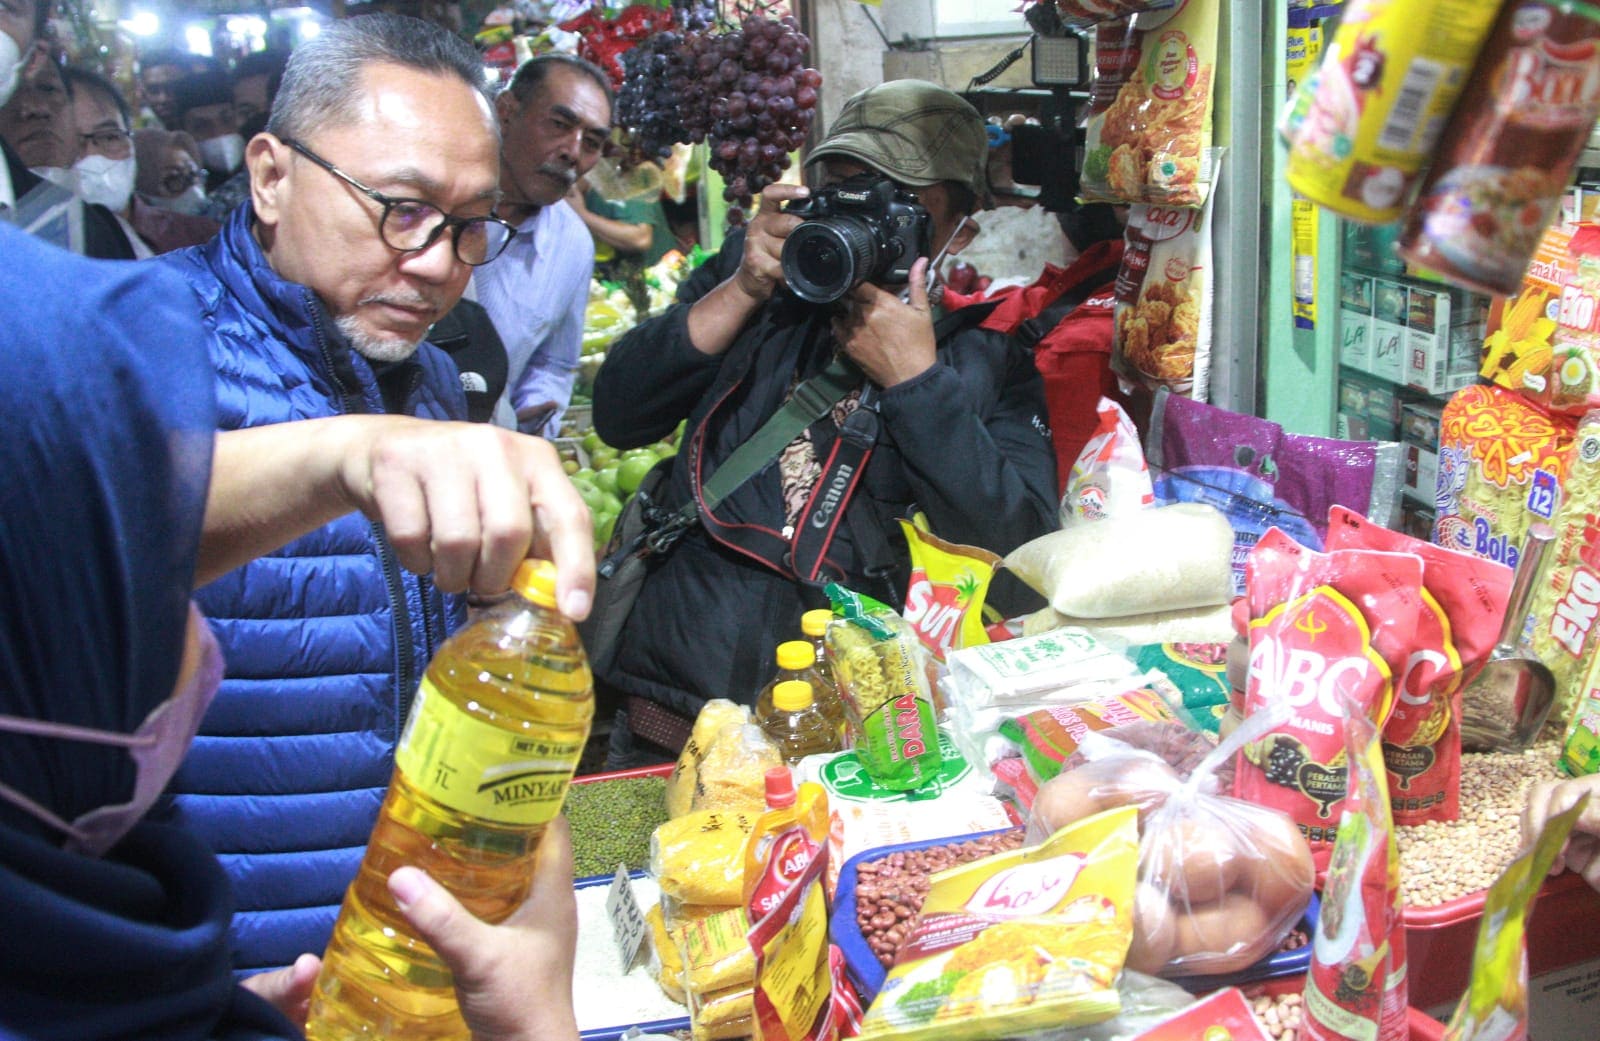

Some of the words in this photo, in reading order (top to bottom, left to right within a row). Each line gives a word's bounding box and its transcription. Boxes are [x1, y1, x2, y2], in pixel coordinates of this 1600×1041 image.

[838, 190, 867, 201] Canon
[1529, 261, 1566, 285] enaku
[1376, 335, 1399, 358] LA
[812, 464, 853, 528] Canon
[1532, 487, 1551, 514] 12
[1475, 517, 1519, 567] Bola
[903, 580, 961, 651] Sun
[1552, 567, 1600, 656] EKO
[1249, 634, 1369, 718] ABC
[894, 692, 926, 759] DARA
[435, 768, 449, 790] 1L
